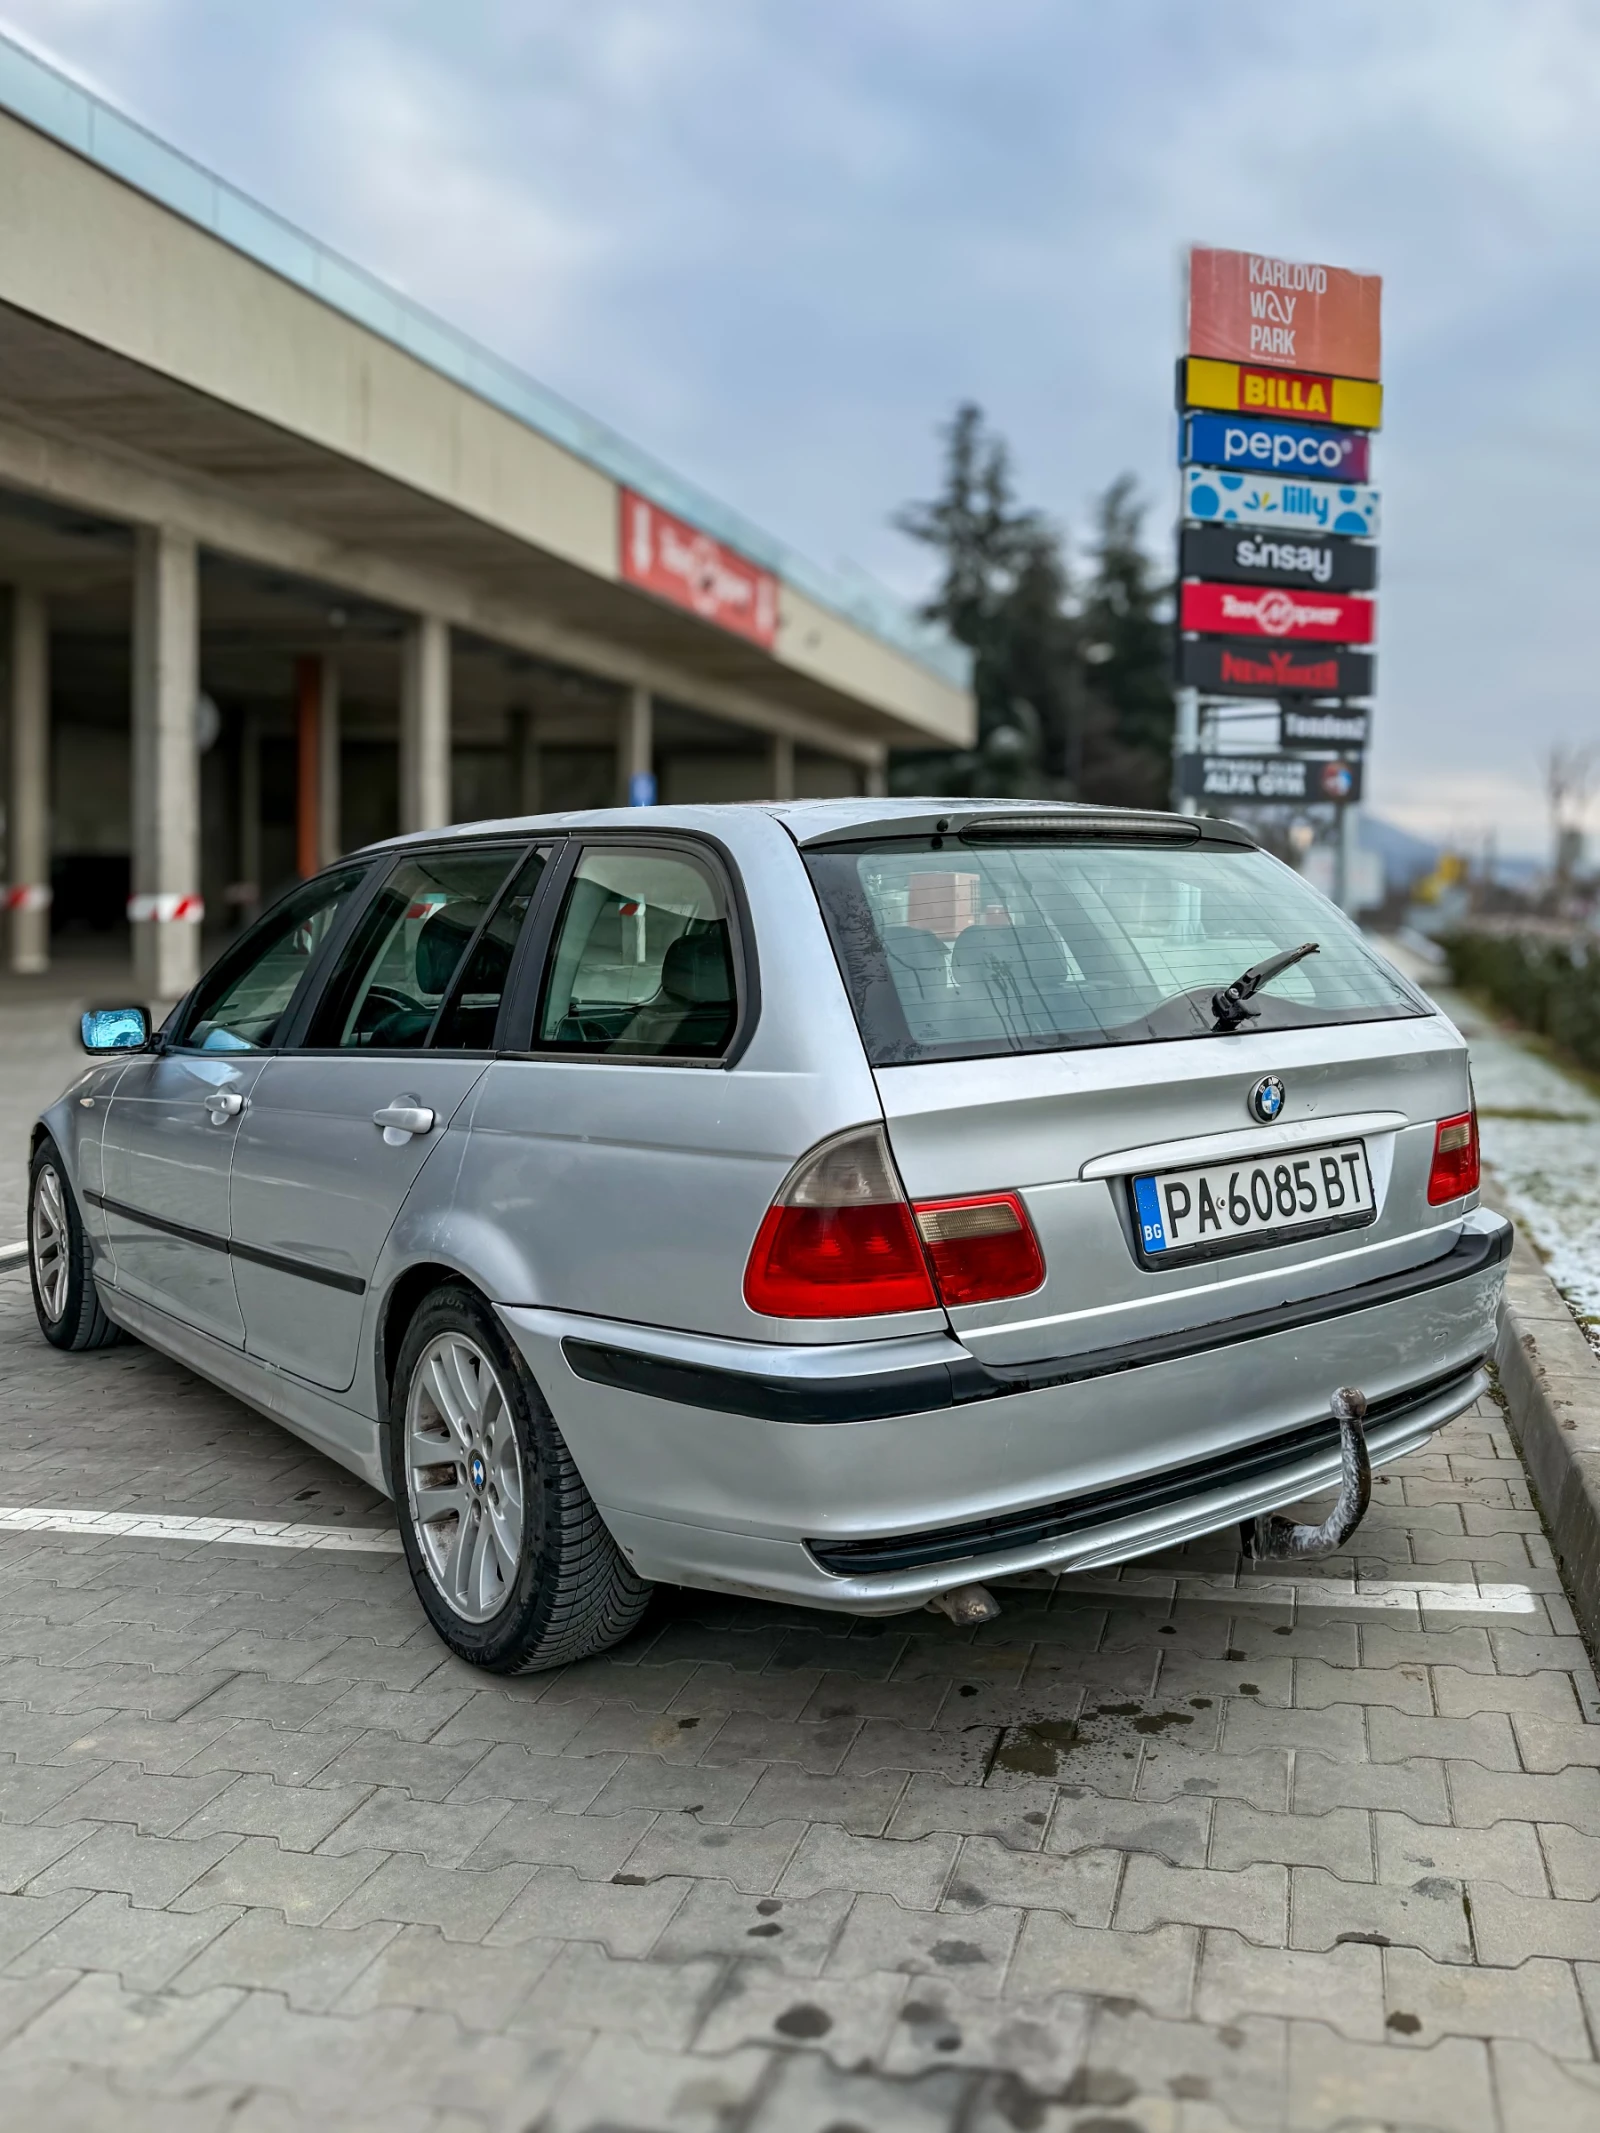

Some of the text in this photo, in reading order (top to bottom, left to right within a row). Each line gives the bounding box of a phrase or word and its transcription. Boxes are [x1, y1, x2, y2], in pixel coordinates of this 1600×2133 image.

[1250, 257, 1327, 294] KARLOVO
[1250, 324, 1296, 355] PARK
[1244, 374, 1327, 413] BILLA
[1282, 485, 1328, 525] lilly
[1144, 1224, 1162, 1240] BG
